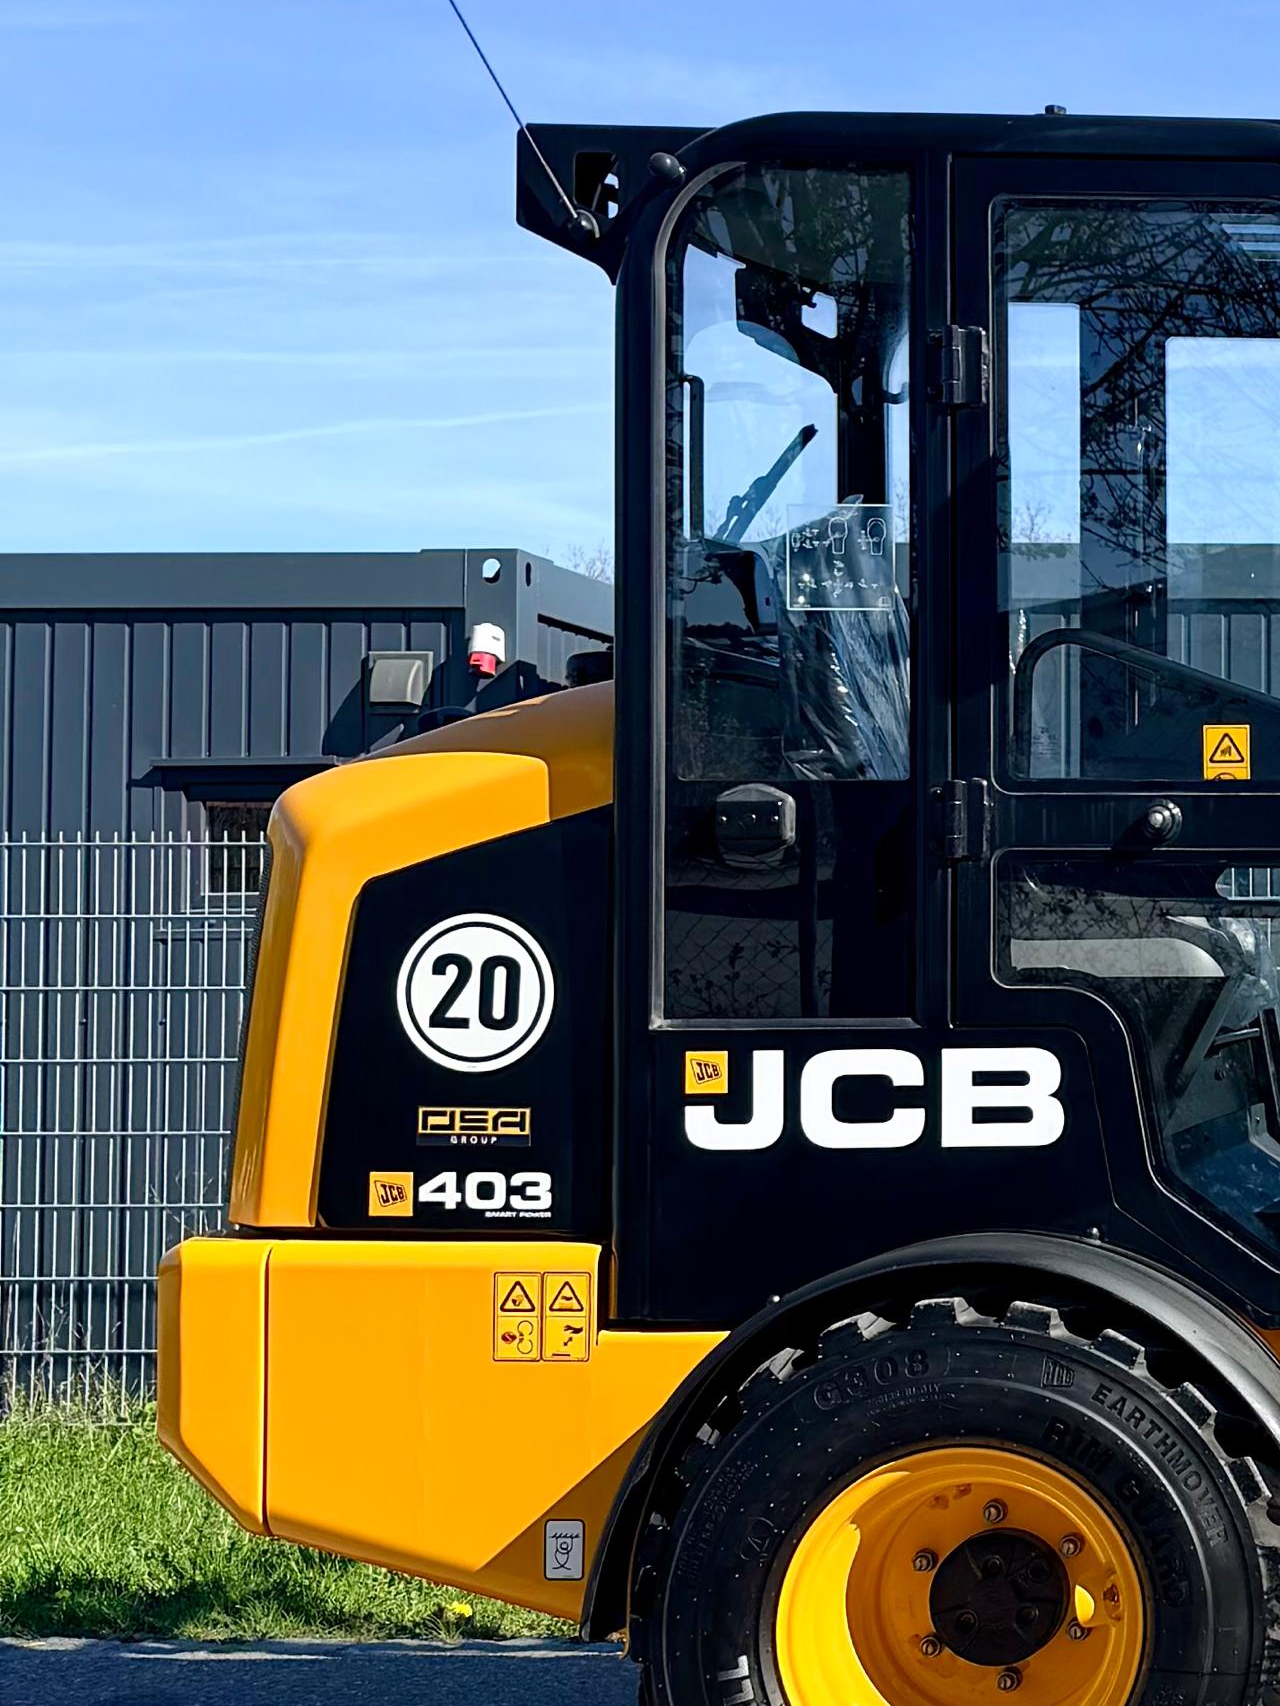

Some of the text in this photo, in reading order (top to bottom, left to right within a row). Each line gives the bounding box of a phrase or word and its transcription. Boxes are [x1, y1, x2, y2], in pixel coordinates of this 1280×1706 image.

[428, 952, 521, 1031] 20
[695, 1059, 721, 1082] JCB
[684, 1047, 1065, 1151] JCB
[450, 1135, 498, 1145] GROUP
[379, 1183, 406, 1206] JCB
[418, 1171, 552, 1210] 403
[1090, 1383, 1229, 1548] EARTHMOVER
